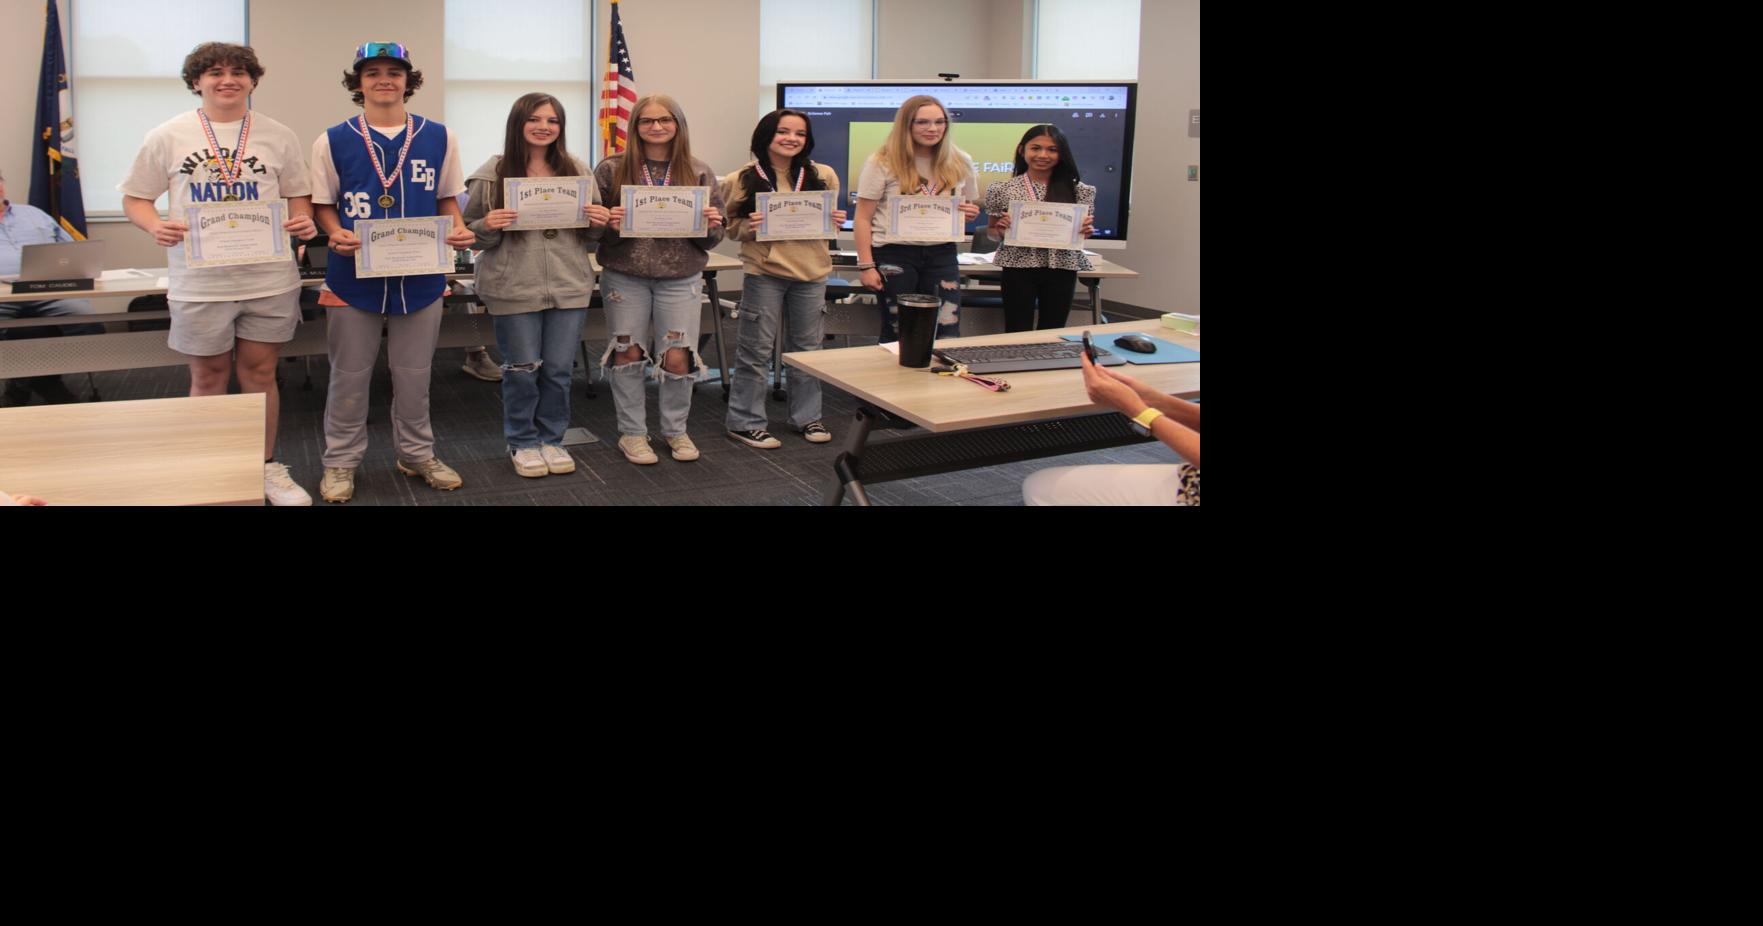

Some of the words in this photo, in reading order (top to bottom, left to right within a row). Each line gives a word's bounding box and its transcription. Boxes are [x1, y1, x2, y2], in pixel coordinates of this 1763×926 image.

[520, 190, 532, 201] 1st
[534, 187, 555, 195] Place
[557, 186, 577, 198] Team
[343, 191, 372, 219] 36
[635, 197, 647, 208] 1st
[649, 195, 670, 203] Place
[672, 195, 693, 208] Team
[804, 199, 823, 210] Team
[933, 203, 951, 214] Team
[200, 213, 226, 229] Grand
[228, 212, 271, 225] Champion
[1055, 210, 1073, 223] Team
[371, 228, 395, 242] Grand
[397, 227, 436, 239] Champion
